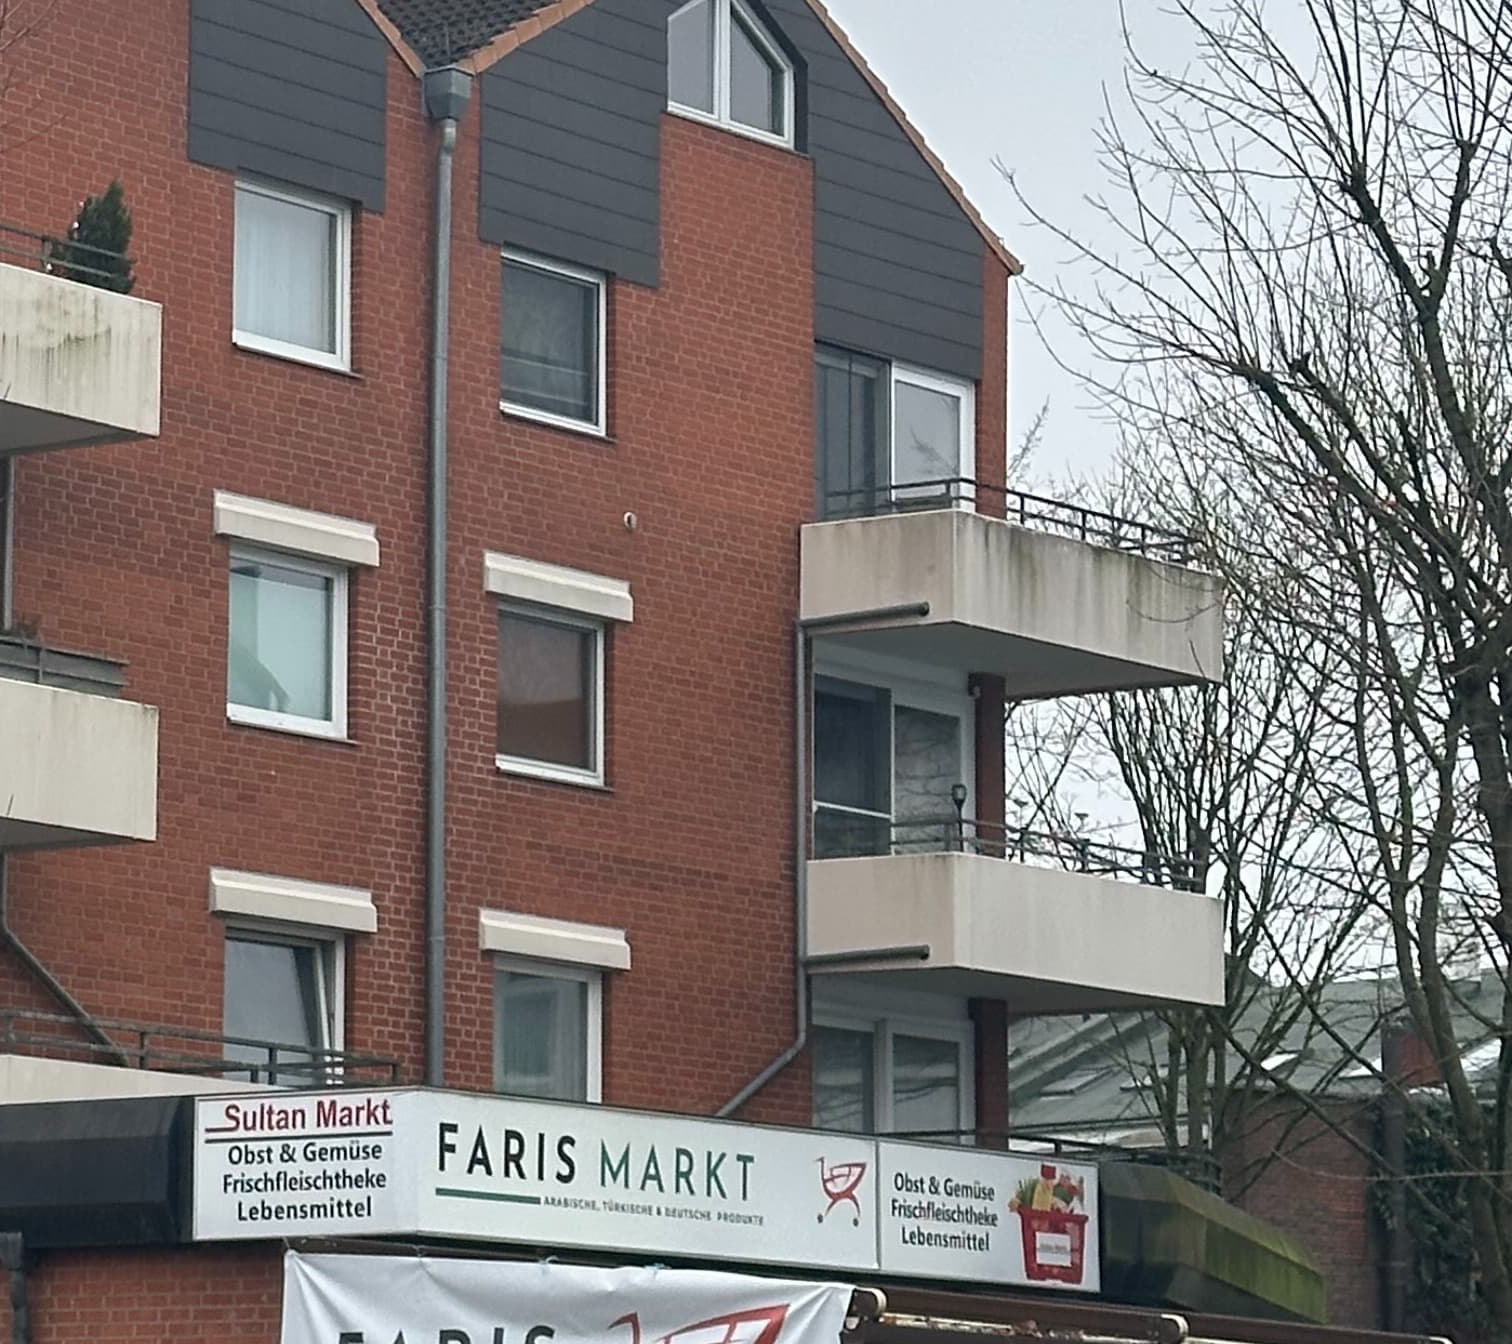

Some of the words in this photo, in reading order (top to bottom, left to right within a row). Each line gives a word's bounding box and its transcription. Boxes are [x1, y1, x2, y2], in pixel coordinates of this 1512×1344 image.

[223, 1102, 306, 1133] Sultan
[316, 1099, 392, 1129] Markt
[228, 1144, 274, 1165] Obst
[279, 1142, 297, 1163] &
[303, 1140, 383, 1162] Gemüse
[438, 1121, 576, 1184] FARIS
[600, 1138, 755, 1201] MARKT
[223, 1168, 387, 1194] Frischfleischtheke
[894, 1172, 924, 1194] Obst
[928, 1175, 941, 1195] &
[943, 1177, 995, 1202] Gemüse
[237, 1195, 372, 1222] Lebensmittel
[543, 1196, 600, 1212] ARABISCHE,
[603, 1199, 653, 1216] TÜRKISCHE
[656, 1206, 662, 1216] &
[665, 1207, 711, 1221] DEUTSCHE
[717, 1212, 764, 1225] PRODUKTE
[891, 1198, 999, 1228] Frischfleischtheke
[901, 1225, 990, 1252] Lebensmittel
